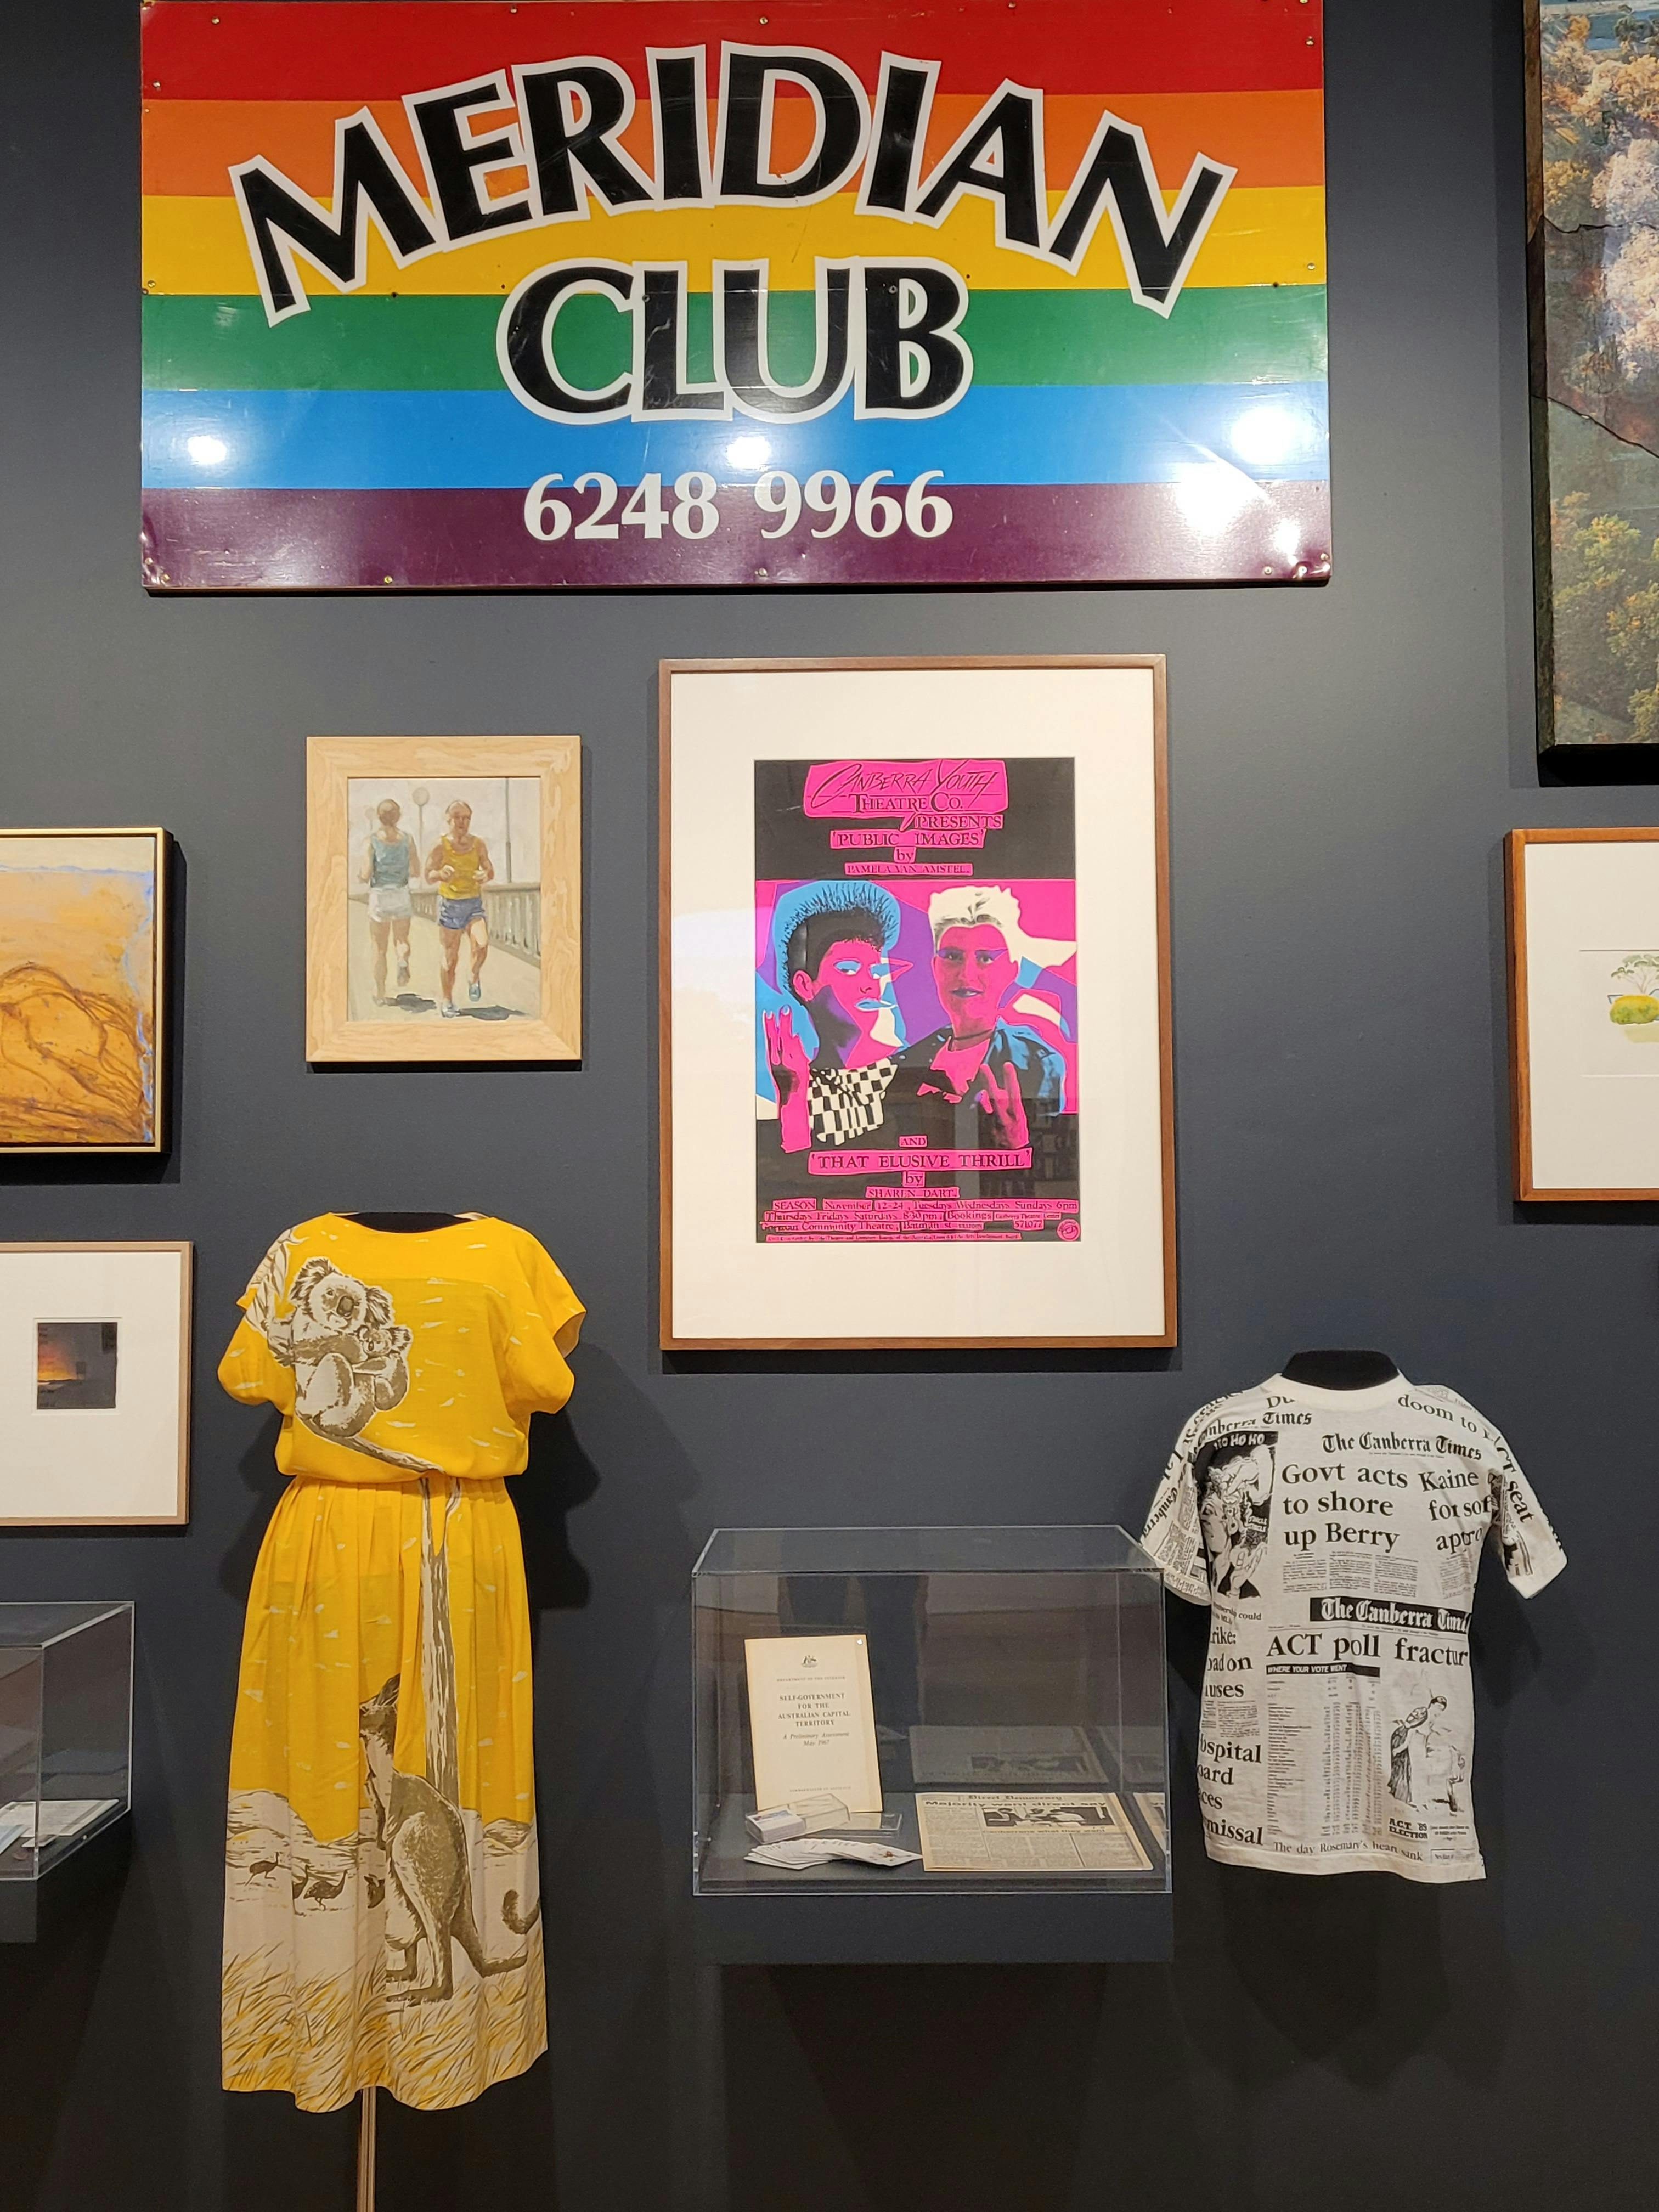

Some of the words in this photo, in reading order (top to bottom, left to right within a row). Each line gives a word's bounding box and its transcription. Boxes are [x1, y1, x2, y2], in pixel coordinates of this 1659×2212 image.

[229, 41, 1237, 325] MERIDIAN
[496, 256, 974, 426] CLUB
[523, 470, 720, 542] 6248
[753, 467, 955, 540] 9966
[811, 763, 933, 809] CANBERRA
[930, 759, 999, 809] YOUTH
[849, 793, 927, 813] THEATRE
[917, 816, 1002, 828] PRESENTS
[896, 849, 914, 862] by
[848, 865, 891, 873] PAMELA
[895, 865, 917, 873] VAN
[901, 1137, 926, 1146] AND
[879, 1155, 950, 1168] ELUSIVE
[906, 1174, 923, 1186] by
[869, 1189, 916, 1198] SHAREN
[774, 1201, 815, 1209] SEASON
[825, 1200, 870, 1209] November
[913, 1200, 952, 1210] Tuesdays
[957, 1200, 1009, 1210] Wednesdays
[1015, 1200, 1052, 1210] Sundays
[1056, 1201, 1077, 1210] 6pm
[817, 1211, 849, 1221] Fridays
[855, 1211, 898, 1221] Saturdays
[948, 1211, 991, 1220] Bookings
[802, 1222, 857, 1232] Community
[1262, 1412, 1312, 1425] Times
[1231, 1433, 1247, 1447] HO
[1249, 1433, 1265, 1445] HO
[1322, 1433, 1355, 1453] The
[1359, 1431, 1431, 1452] Canberra
[1436, 1435, 1482, 1460] Times
[1398, 1395, 1454, 1422] doom
[1460, 1416, 1477, 1433] to
[1509, 1480, 1534, 1523] seat
[1282, 1463, 1346, 1484] Govt
[1357, 1467, 1408, 1488] acts
[1418, 1469, 1479, 1492] Kaine
[1283, 1497, 1310, 1515] to
[1318, 1490, 1394, 1516] shore
[1284, 1528, 1317, 1551] up
[1325, 1522, 1401, 1554] Berry
[1321, 1598, 1354, 1620] The
[1356, 1600, 1434, 1628] Canberra
[1266, 1633, 1323, 1657] ACT
[1333, 1634, 1381, 1661] poll
[1227, 1657, 1253, 1672] on
[780, 1693, 845, 1701] SELF-GOVERNMENT
[1389, 1825, 1428, 1839] ELECTION
[1273, 1841, 1291, 1853] The
[1296, 1843, 1316, 1854] day
